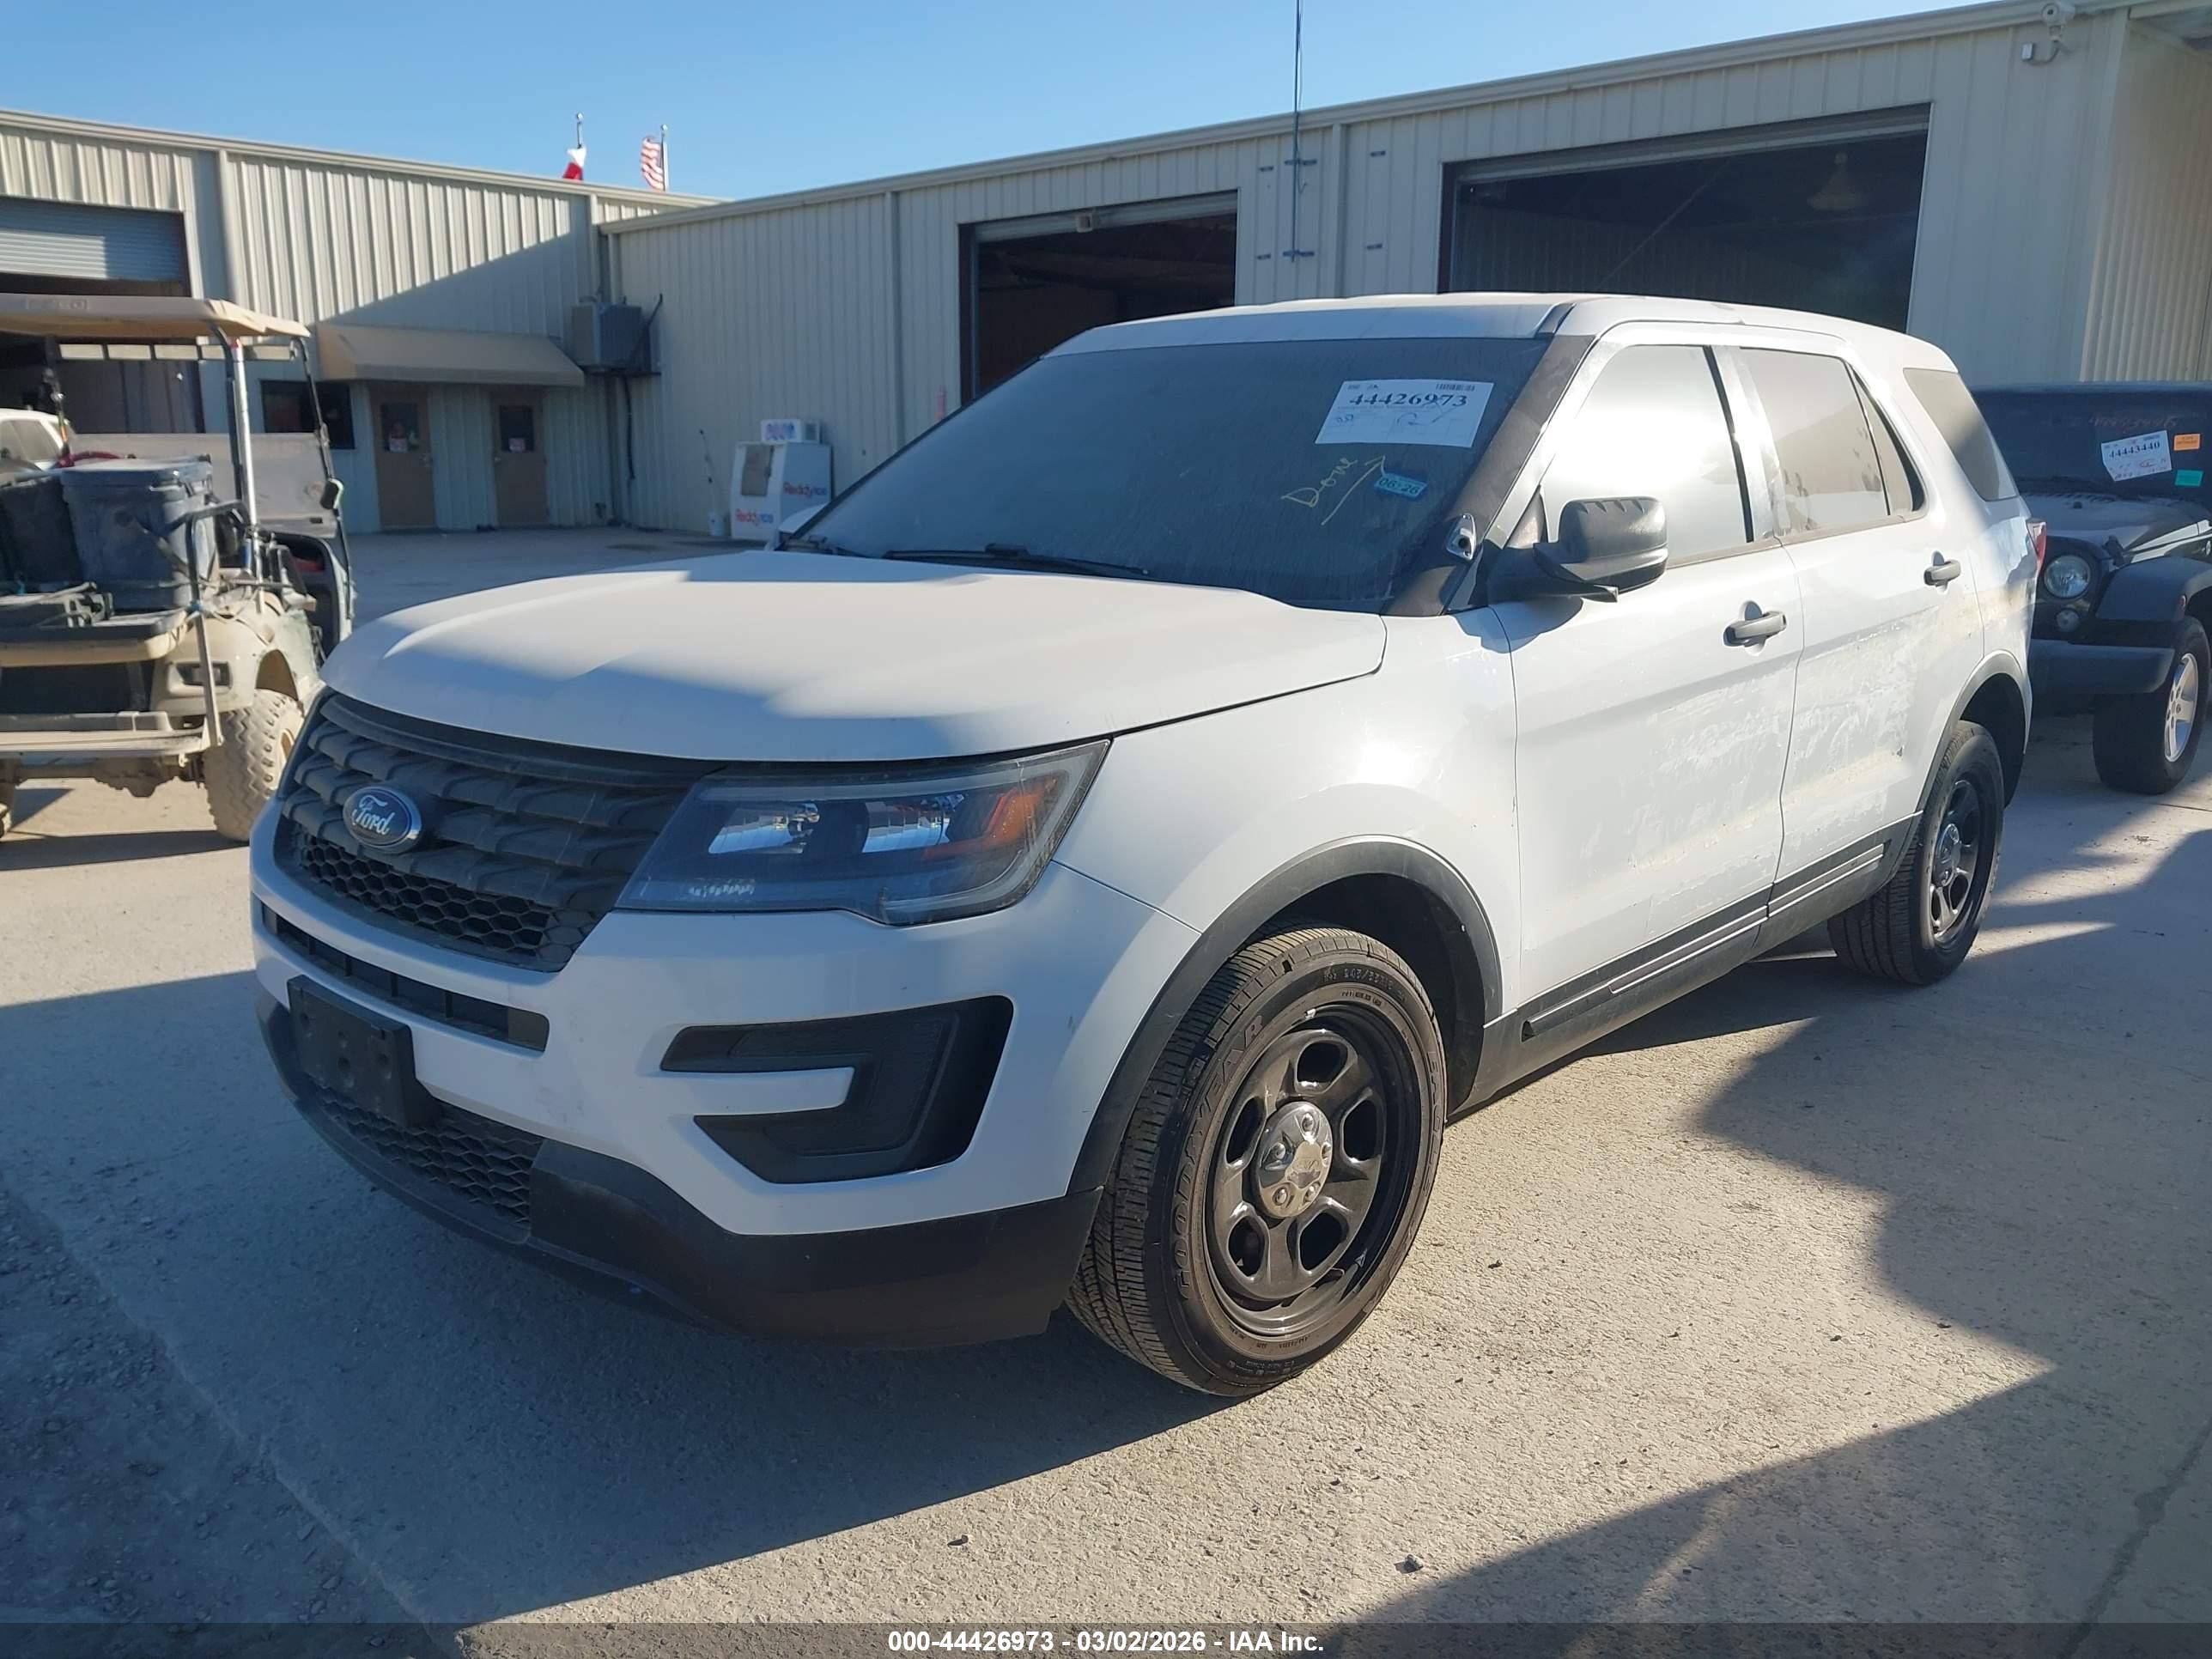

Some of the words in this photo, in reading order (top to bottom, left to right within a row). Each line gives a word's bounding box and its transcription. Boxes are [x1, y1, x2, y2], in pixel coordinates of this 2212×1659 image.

[1349, 392, 1468, 407] 44426973
[351, 795, 395, 836] Ford
[1174, 1014, 1265, 1300] GOODYEAR
